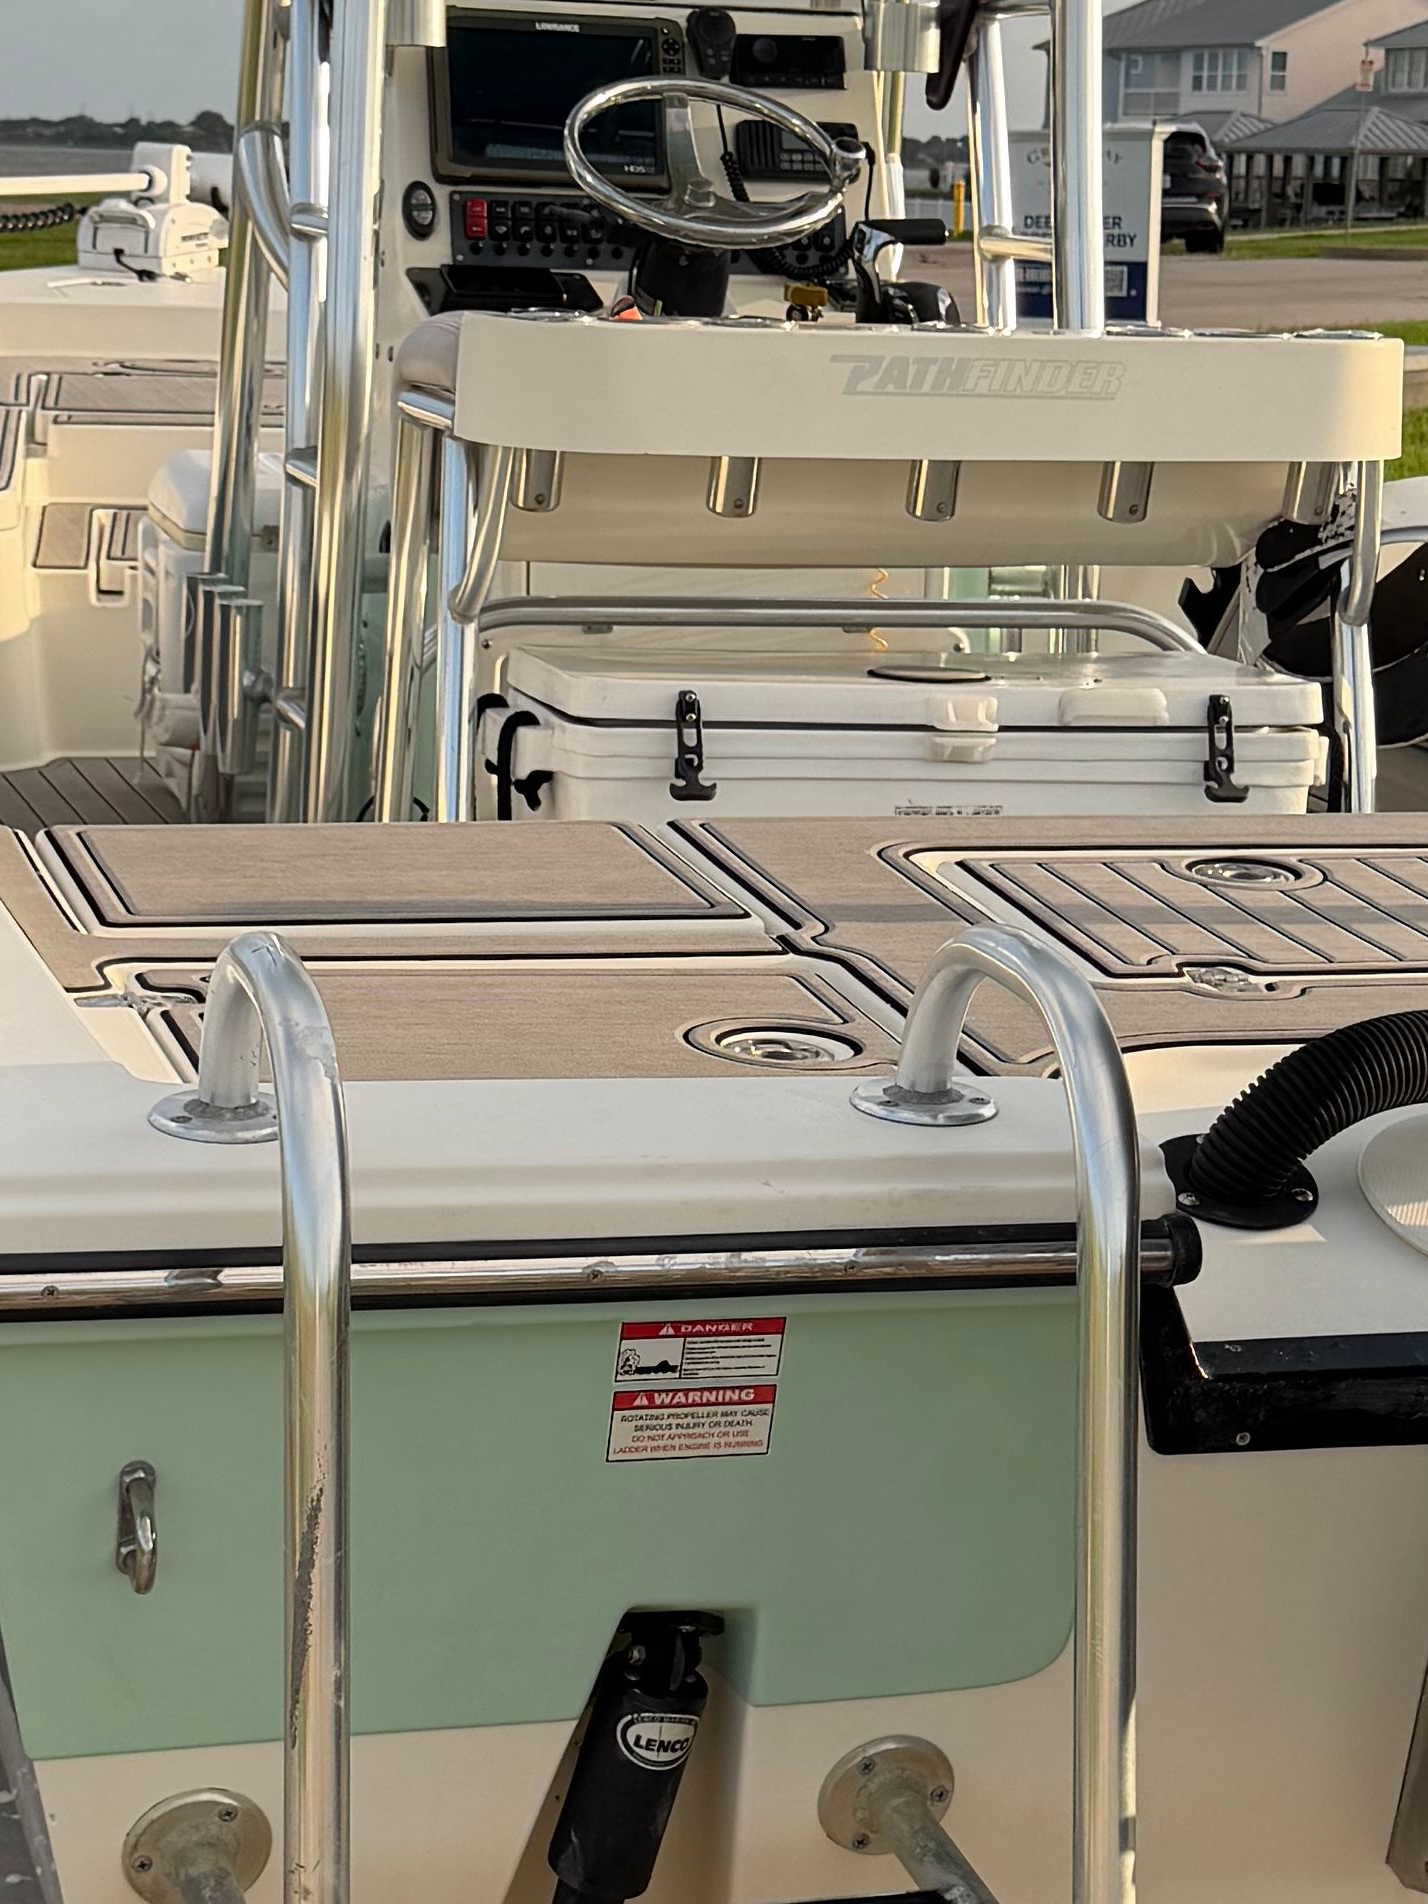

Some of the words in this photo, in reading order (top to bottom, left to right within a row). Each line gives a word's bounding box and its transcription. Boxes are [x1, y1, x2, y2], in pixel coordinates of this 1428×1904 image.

[829, 354, 1128, 400] PATHFINDER
[680, 1323, 753, 1333] DANGER
[654, 1389, 755, 1405] WARNING
[633, 1734, 690, 1752] LENCO
